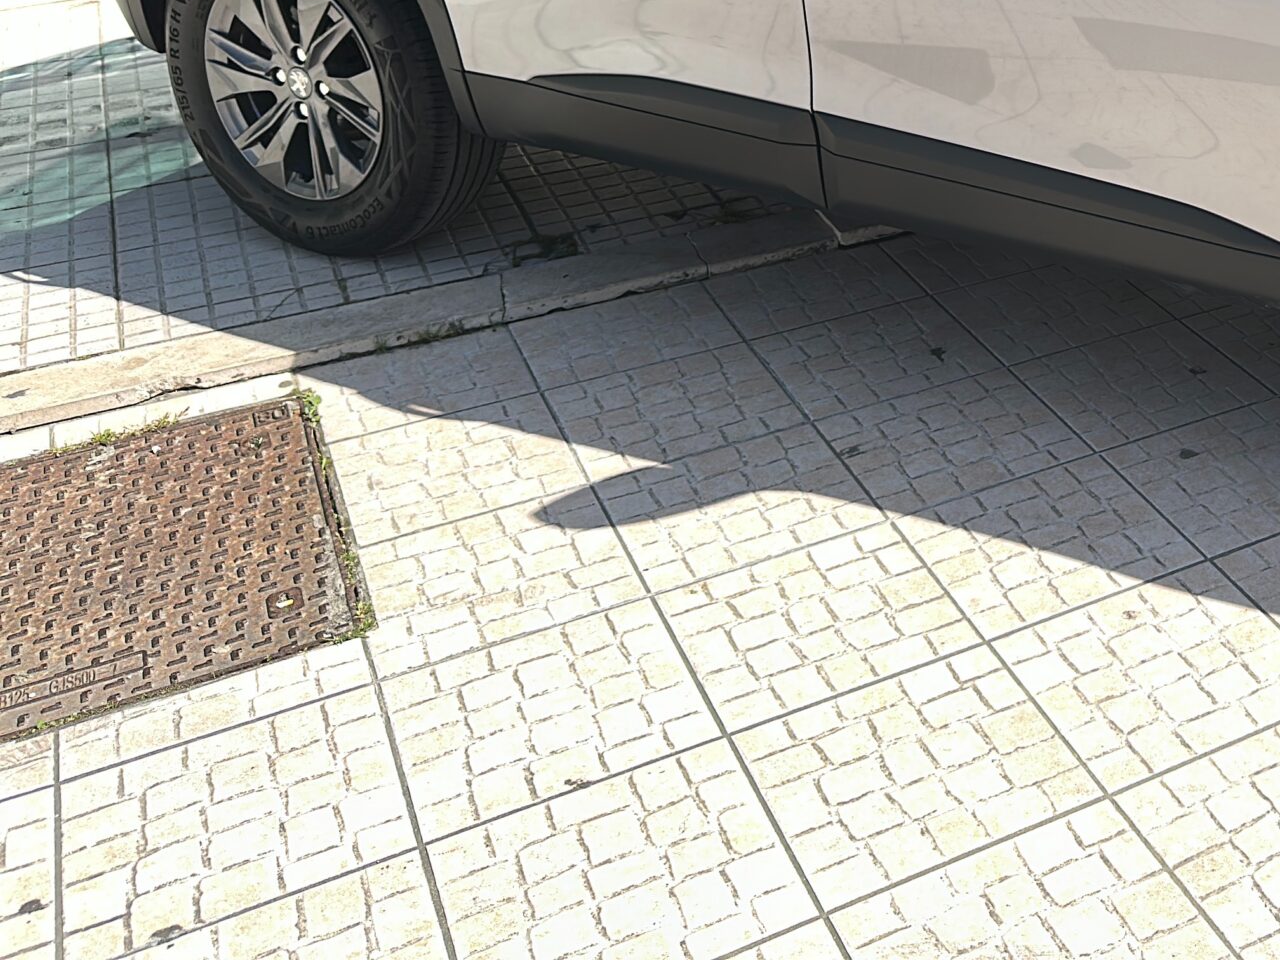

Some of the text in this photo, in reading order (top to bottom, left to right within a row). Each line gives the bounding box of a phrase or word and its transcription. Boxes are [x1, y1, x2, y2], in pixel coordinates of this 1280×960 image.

[169, 8, 196, 122] 215/65 R 16 H
